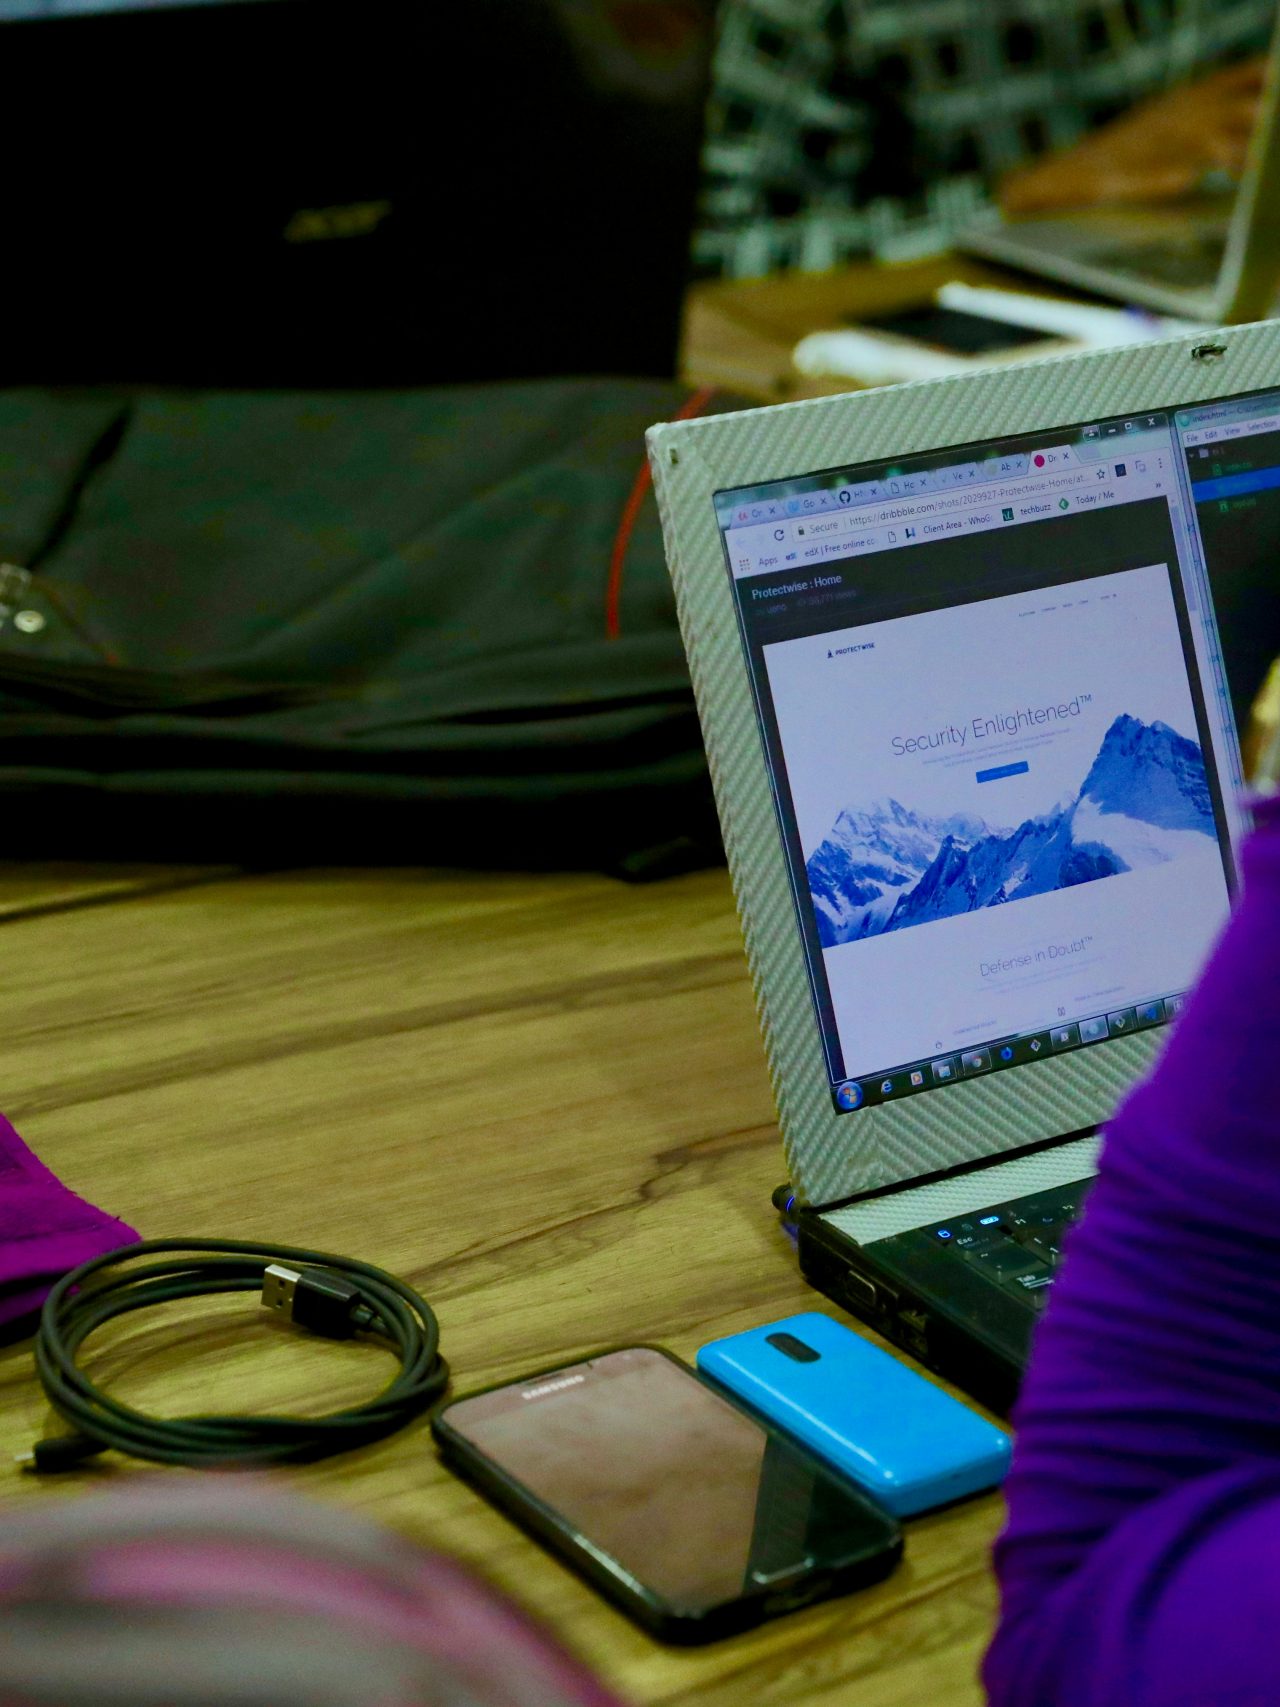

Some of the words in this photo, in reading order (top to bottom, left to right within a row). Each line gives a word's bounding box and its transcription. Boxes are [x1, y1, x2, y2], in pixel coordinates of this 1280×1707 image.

[1186, 434, 1199, 443] File
[1204, 430, 1218, 440] Edit
[1224, 426, 1241, 436] View
[1247, 419, 1278, 432] Selection
[1075, 494, 1097, 507] Today
[1103, 491, 1115, 500] Me
[1020, 503, 1052, 516] techbuzz
[809, 521, 839, 534] Secure
[923, 524, 945, 534] Client
[946, 520, 962, 530] Area
[804, 547, 819, 558] edX
[824, 544, 841, 554] Free
[843, 539, 865, 550] online
[759, 556, 778, 567] Apps
[751, 581, 809, 600] Protectwise
[814, 575, 843, 588] Home
[891, 724, 968, 756] Security
[979, 955, 1032, 977] Defense
[1034, 949, 1046, 963] in
[521, 1374, 585, 1400] SAMSUNG
